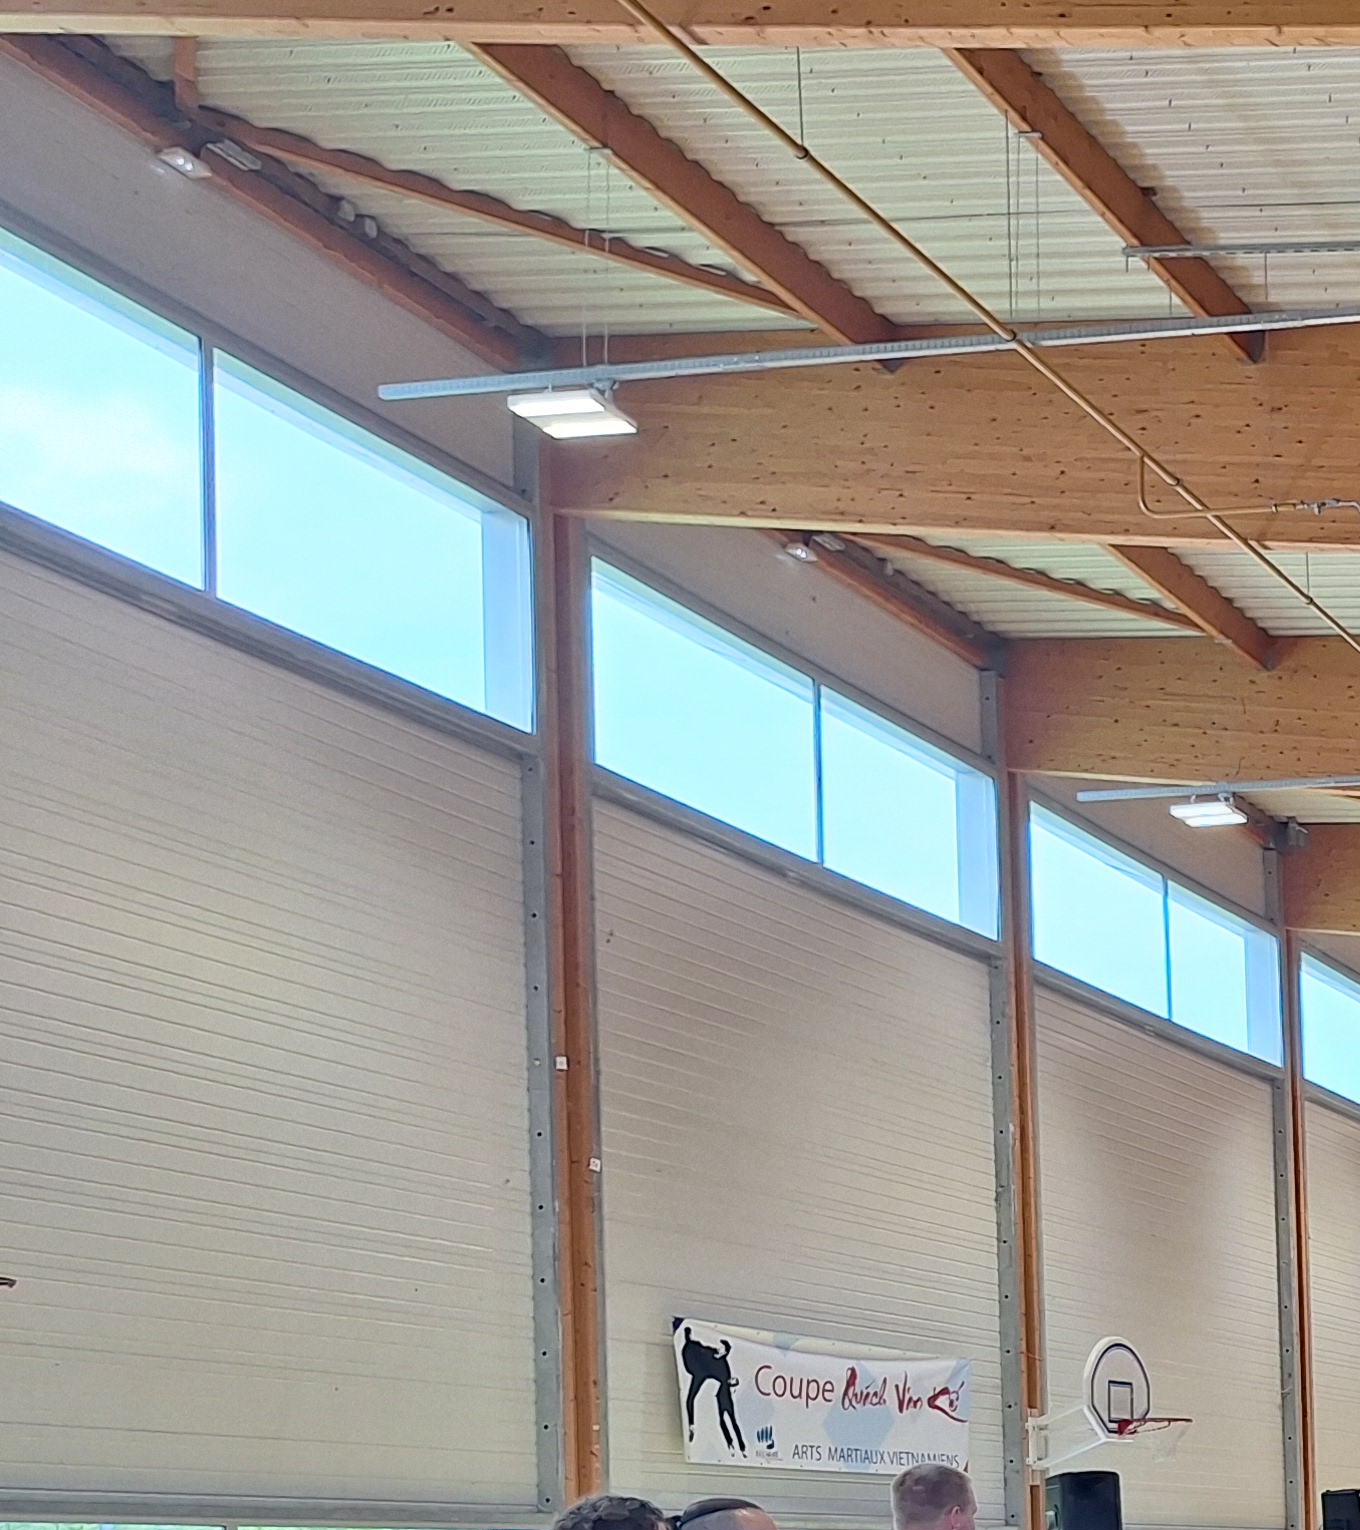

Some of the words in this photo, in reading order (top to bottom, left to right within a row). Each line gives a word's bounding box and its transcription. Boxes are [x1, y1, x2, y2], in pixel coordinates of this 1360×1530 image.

[755, 1365, 834, 1409] Coupe
[792, 1444, 822, 1461] ARTS
[828, 1447, 886, 1465] MARTIAUX
